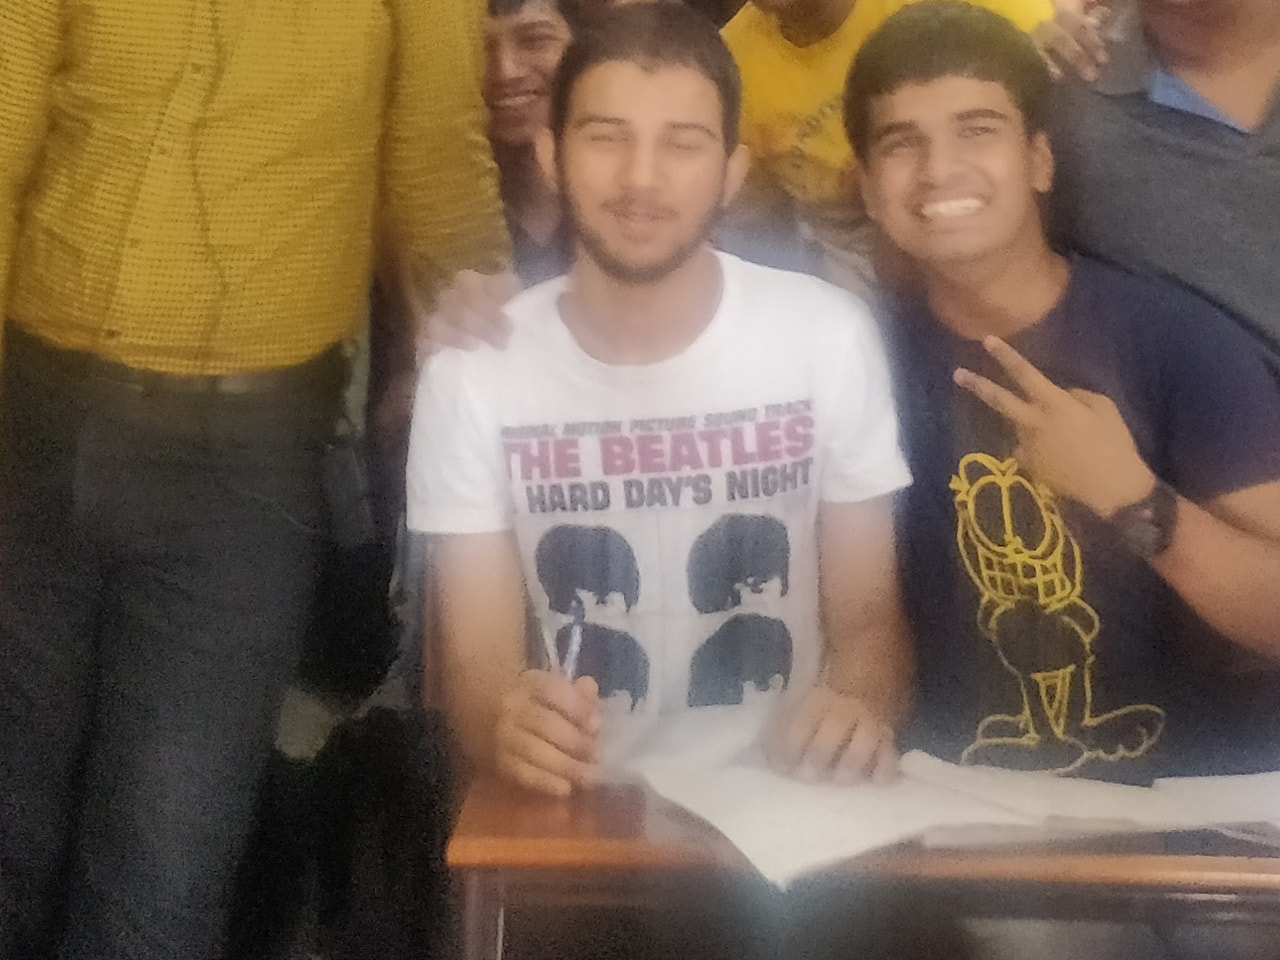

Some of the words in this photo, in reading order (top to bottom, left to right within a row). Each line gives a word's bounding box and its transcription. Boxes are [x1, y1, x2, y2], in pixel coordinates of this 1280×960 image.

[503, 438, 581, 480] THE
[600, 416, 814, 476] BEATLES
[630, 417, 696, 433] PICTURE
[704, 408, 757, 428] SOUND
[525, 482, 611, 513] HARD
[623, 474, 712, 508] DAY'S
[725, 456, 814, 502] NIGHT
